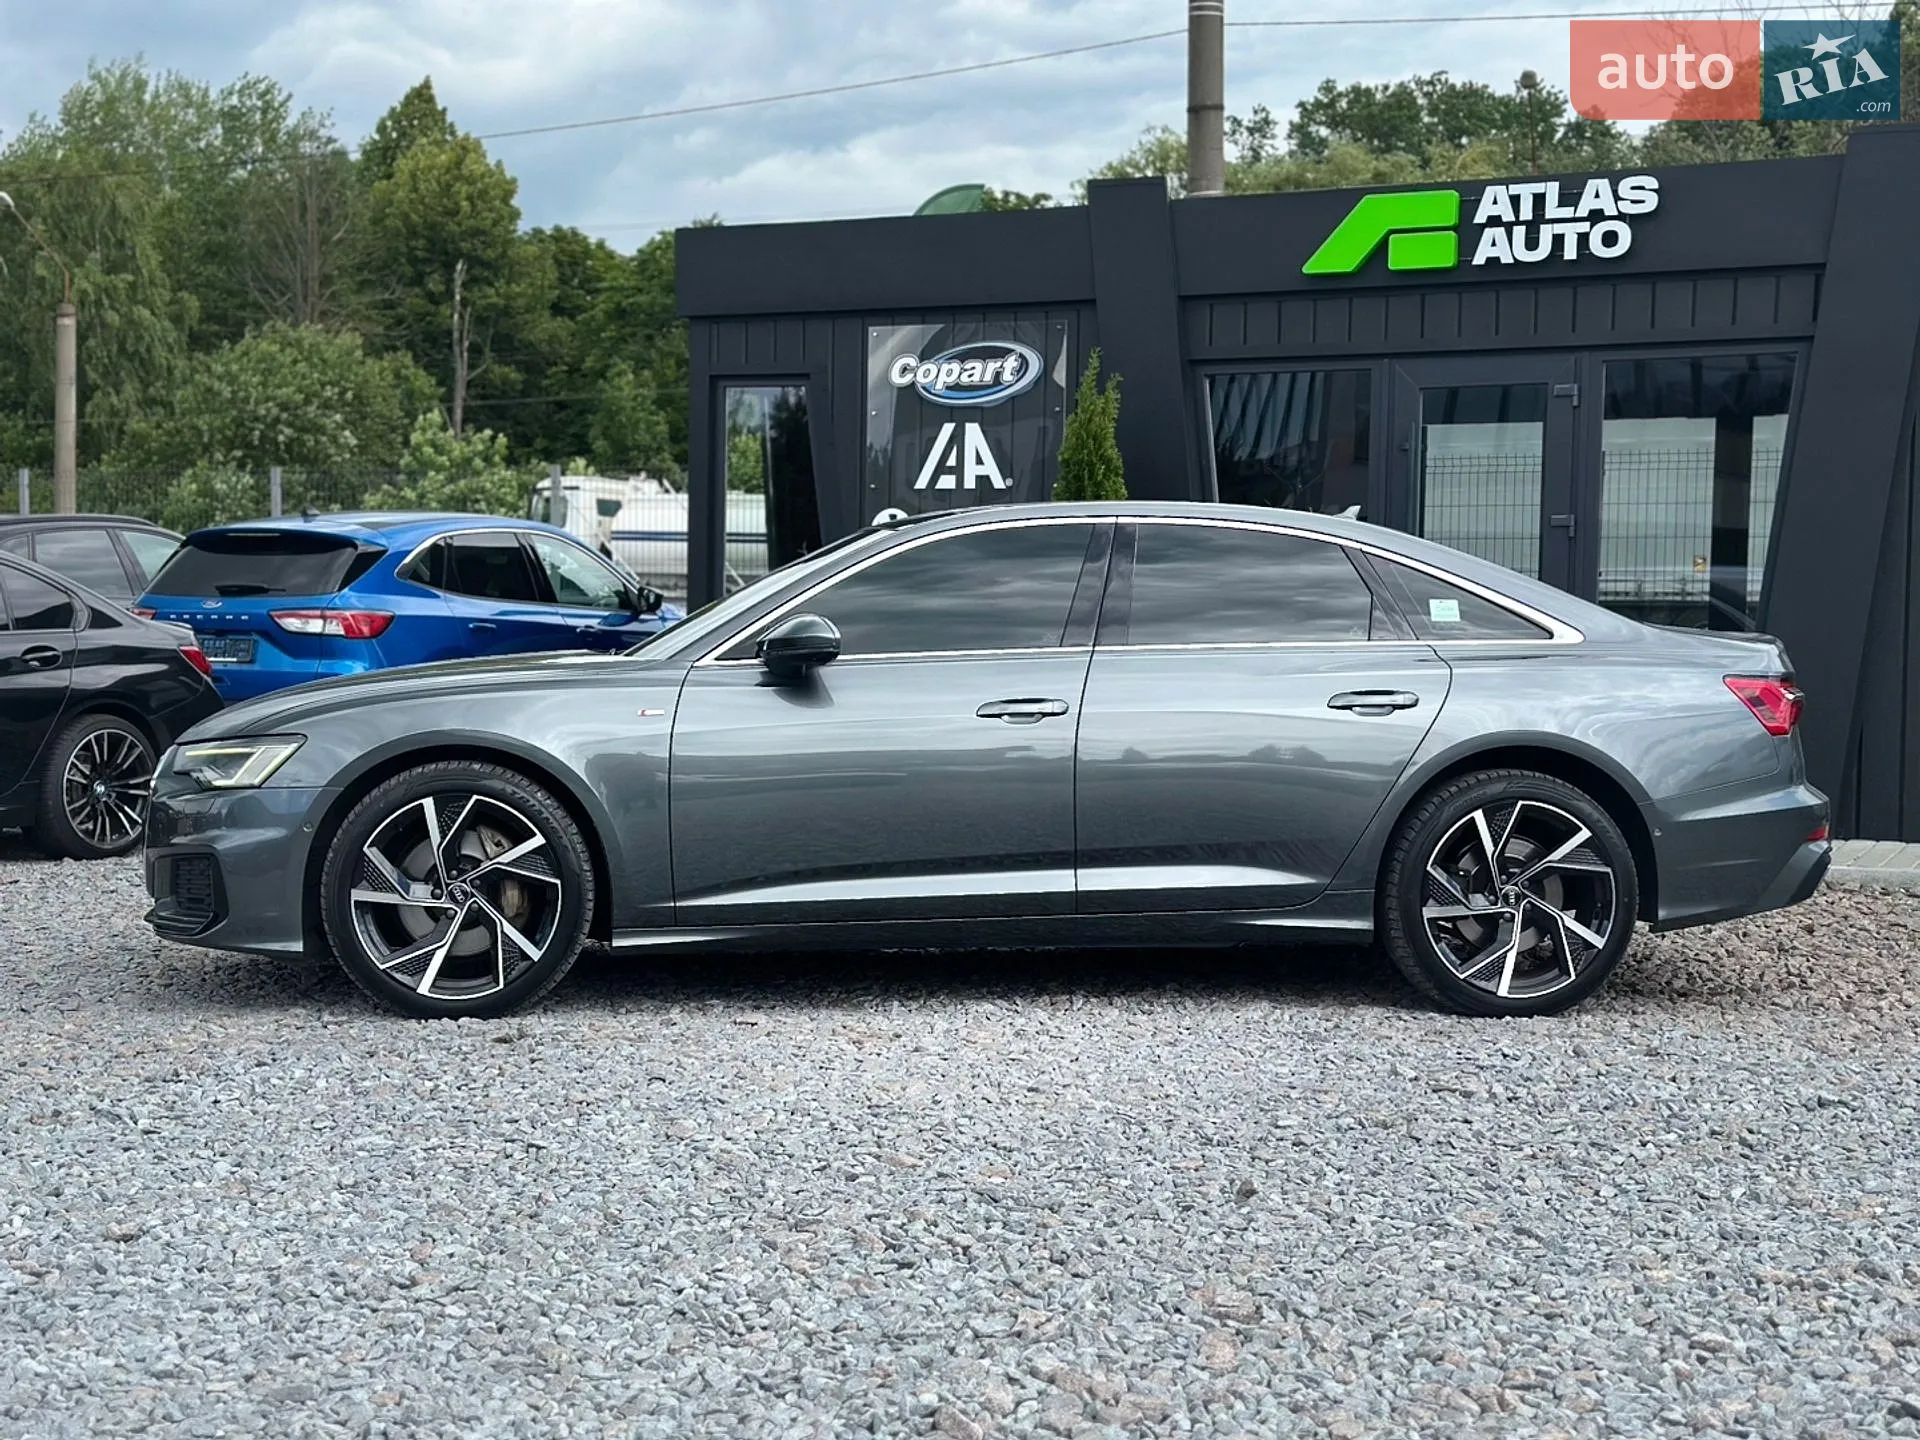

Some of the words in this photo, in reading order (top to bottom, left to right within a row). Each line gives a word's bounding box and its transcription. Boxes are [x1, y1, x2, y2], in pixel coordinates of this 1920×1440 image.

[1472, 175, 1660, 224] ATLAS
[1471, 220, 1633, 266] AUTO
[889, 351, 1022, 392] Copart
